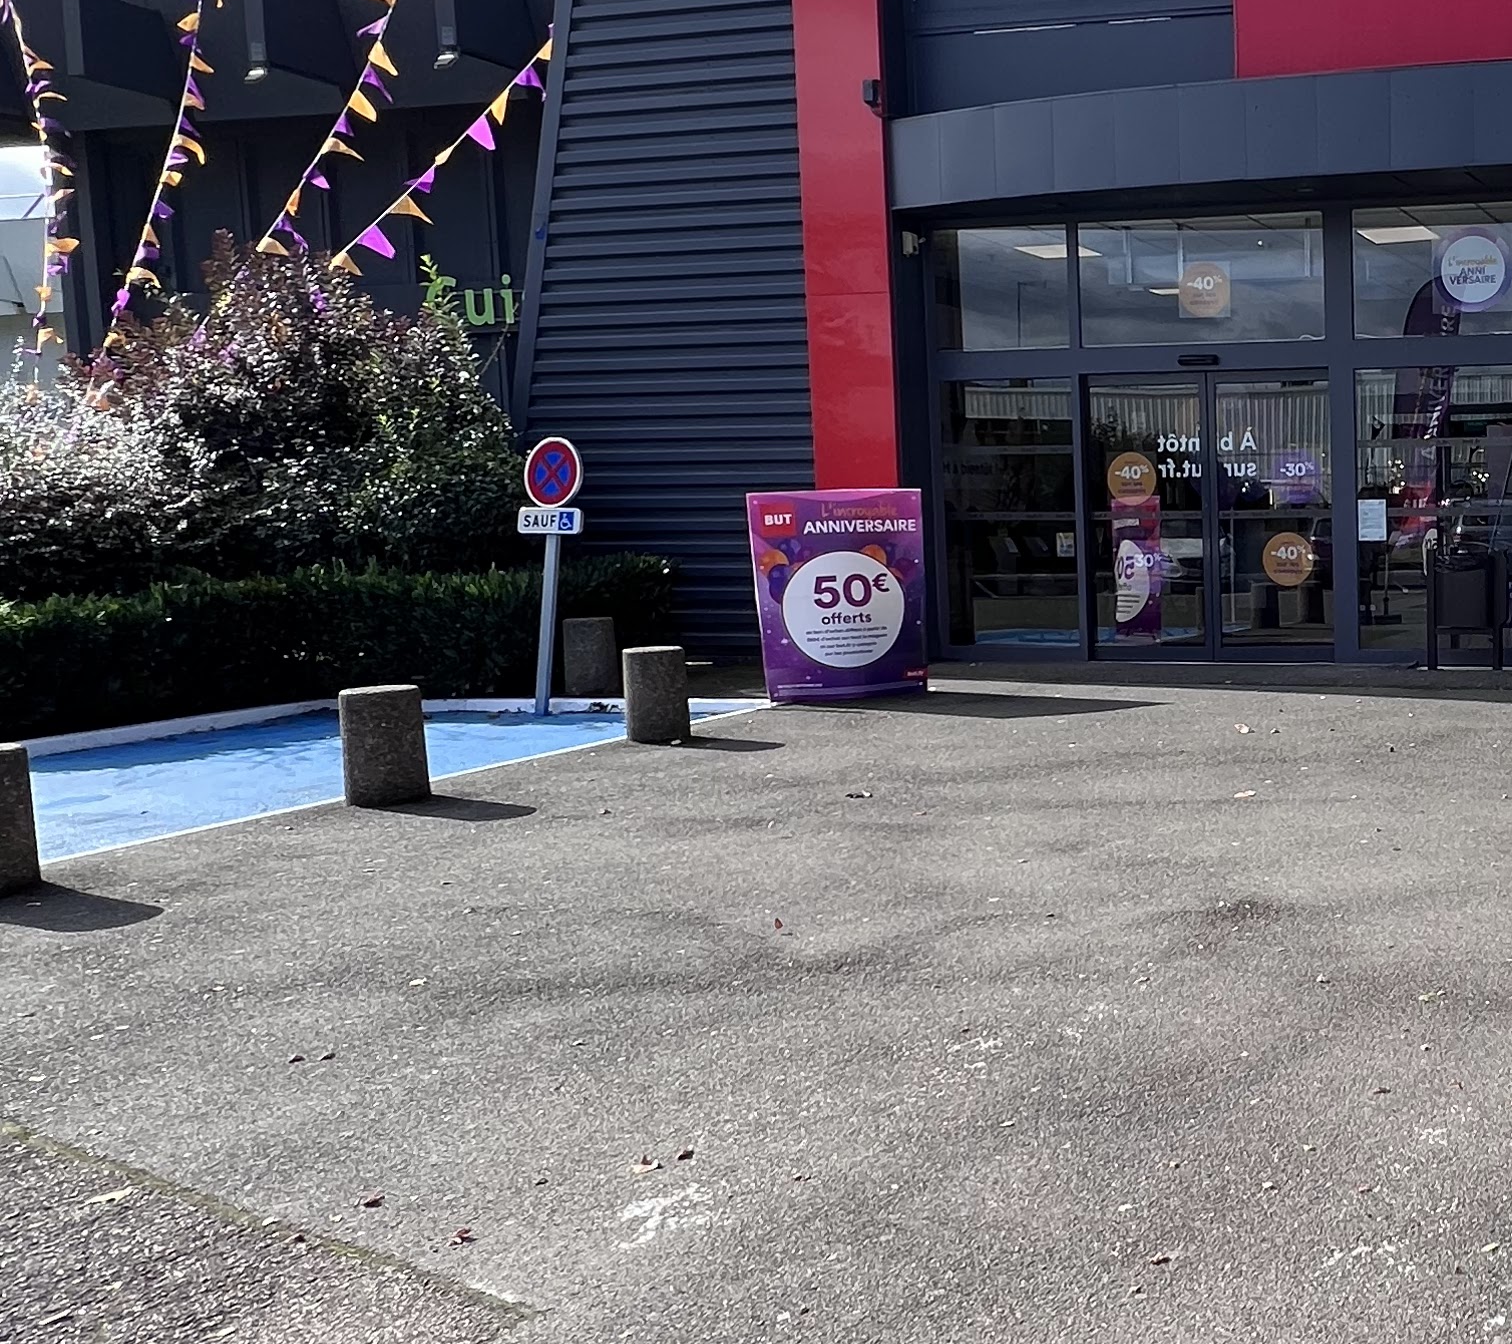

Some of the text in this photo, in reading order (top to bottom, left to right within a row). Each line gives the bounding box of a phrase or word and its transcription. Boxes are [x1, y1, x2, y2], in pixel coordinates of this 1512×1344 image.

[1460, 267, 1486, 276] ANNI
[1186, 274, 1222, 291] -40%
[1450, 275, 1496, 285] VERSAIRE
[1114, 464, 1149, 481] -40%
[1279, 461, 1315, 478] -30%
[820, 503, 899, 519] L'incroyable
[523, 514, 557, 528] SAUF
[764, 513, 792, 526] BUT
[803, 519, 917, 535] ANNIVERSAIRE
[1270, 544, 1306, 560] -40%
[814, 572, 890, 609] 50€
[821, 612, 872, 625] offerts
